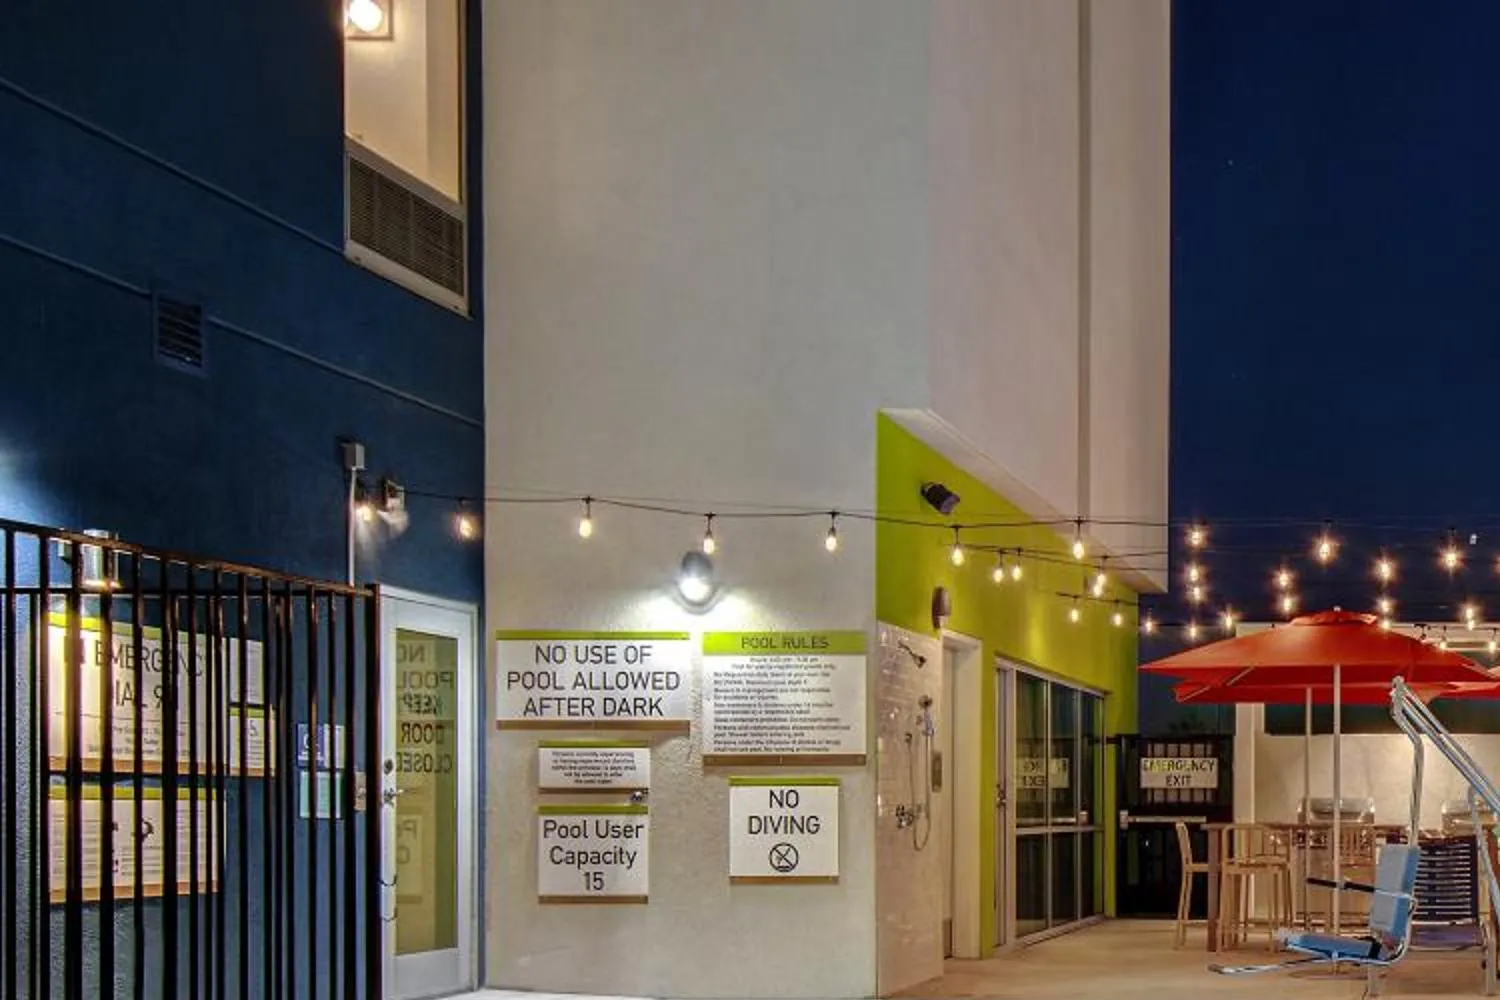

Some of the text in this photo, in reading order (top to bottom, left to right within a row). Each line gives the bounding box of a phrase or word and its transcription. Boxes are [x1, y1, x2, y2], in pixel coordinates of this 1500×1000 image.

[741, 636, 829, 649] POOL RULES
[535, 645, 653, 664] NO USE OF
[507, 671, 680, 690] POOL ALLOWED
[523, 697, 664, 717] AFTER DARK
[1143, 760, 1215, 771] EMERGENCY
[1166, 775, 1192, 787] EXIT
[769, 789, 799, 809] NO
[543, 819, 645, 839] Pool User
[748, 815, 821, 835] DIVING
[549, 844, 637, 870] Capacity
[584, 871, 605, 891] 15
